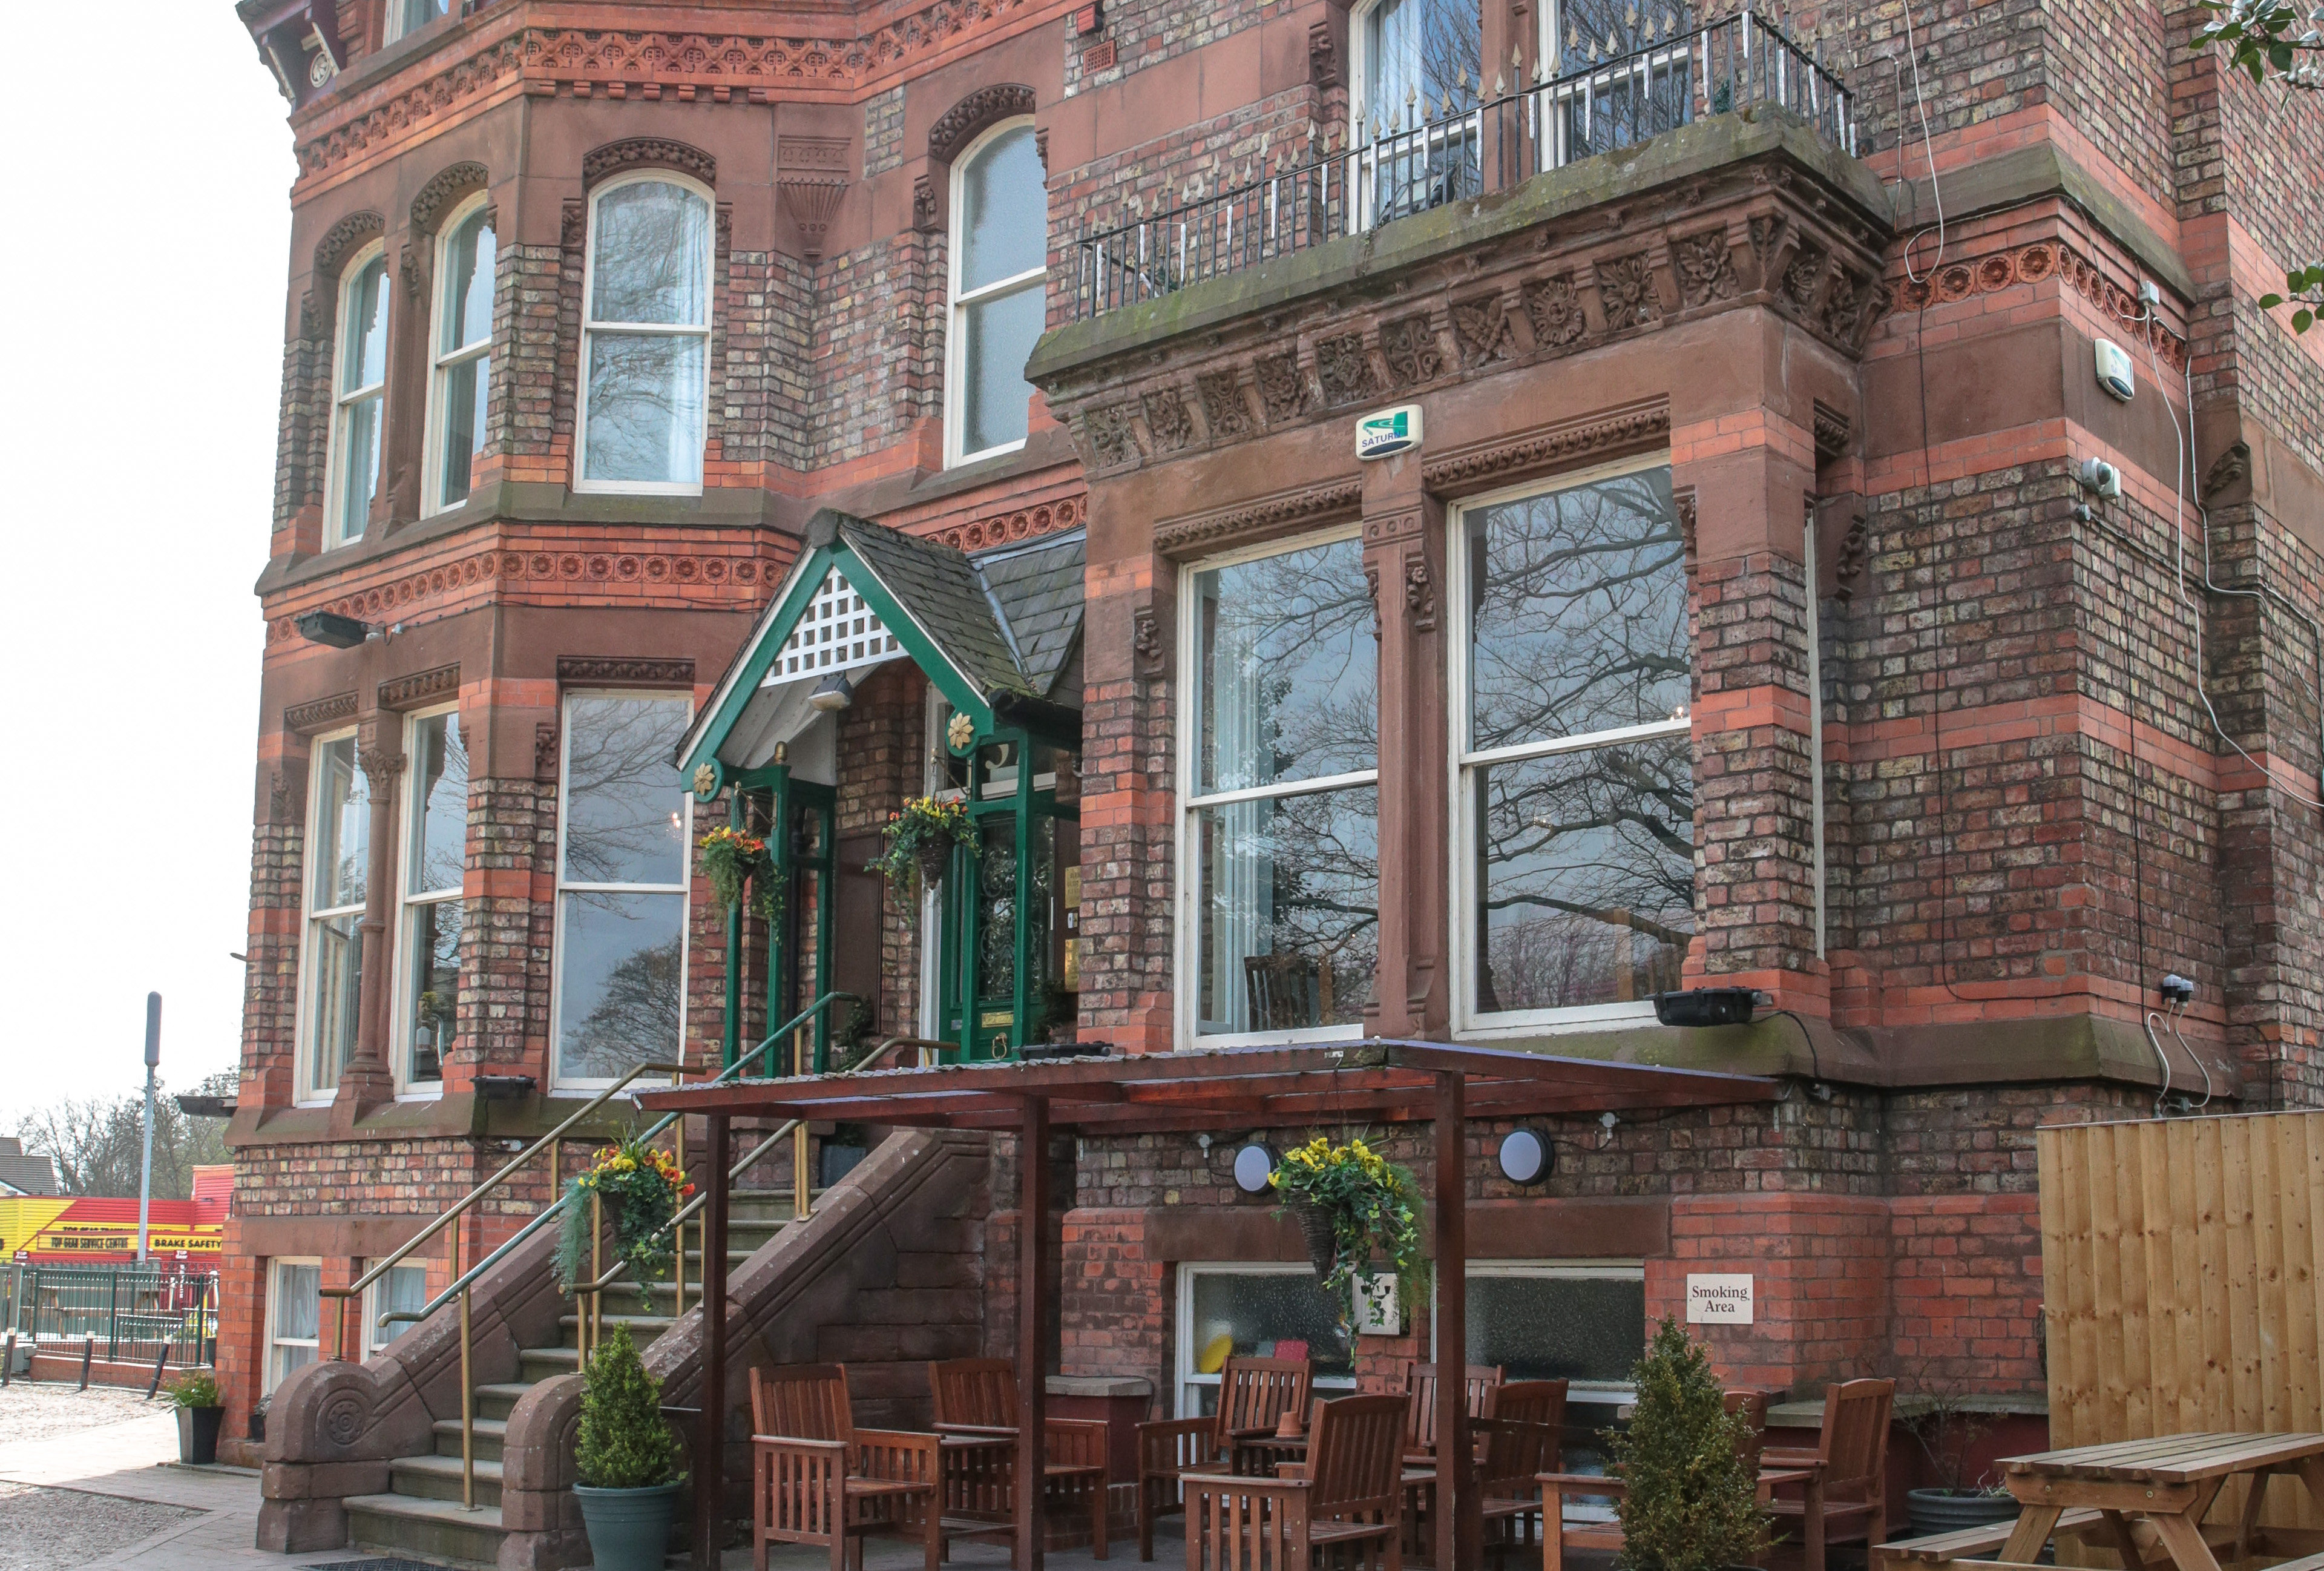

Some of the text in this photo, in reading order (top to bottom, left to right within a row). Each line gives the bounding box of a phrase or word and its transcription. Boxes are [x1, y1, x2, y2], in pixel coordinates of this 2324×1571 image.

[1362, 430, 1400, 447] SATURN
[1692, 1285, 1747, 1301] Smoking
[1704, 1300, 1735, 1312] Area
